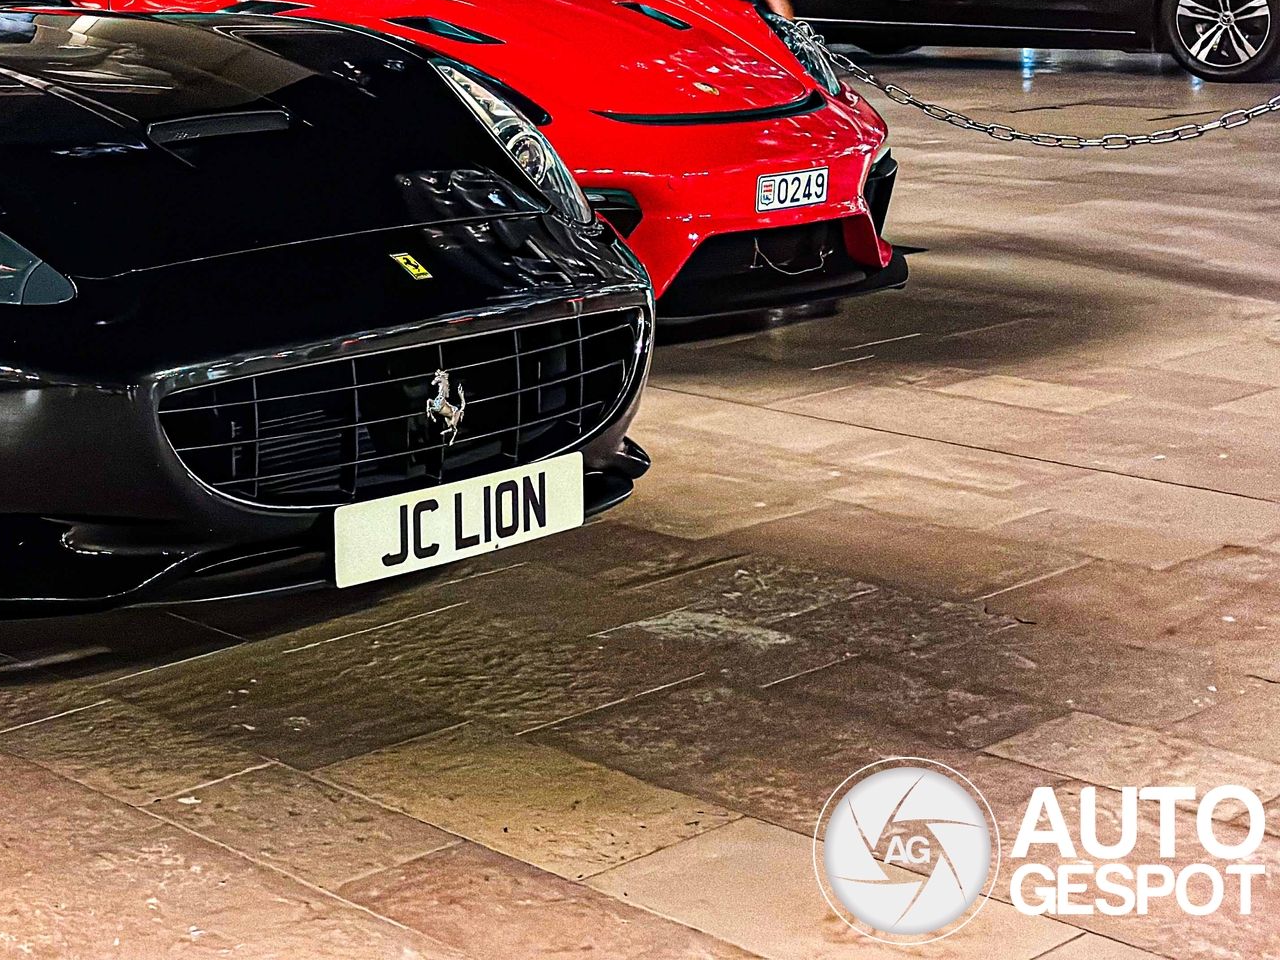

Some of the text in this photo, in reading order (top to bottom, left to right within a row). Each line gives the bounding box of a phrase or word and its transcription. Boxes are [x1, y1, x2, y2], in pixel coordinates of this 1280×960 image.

[777, 172, 825, 205] 0249
[381, 471, 546, 567] JC LION
